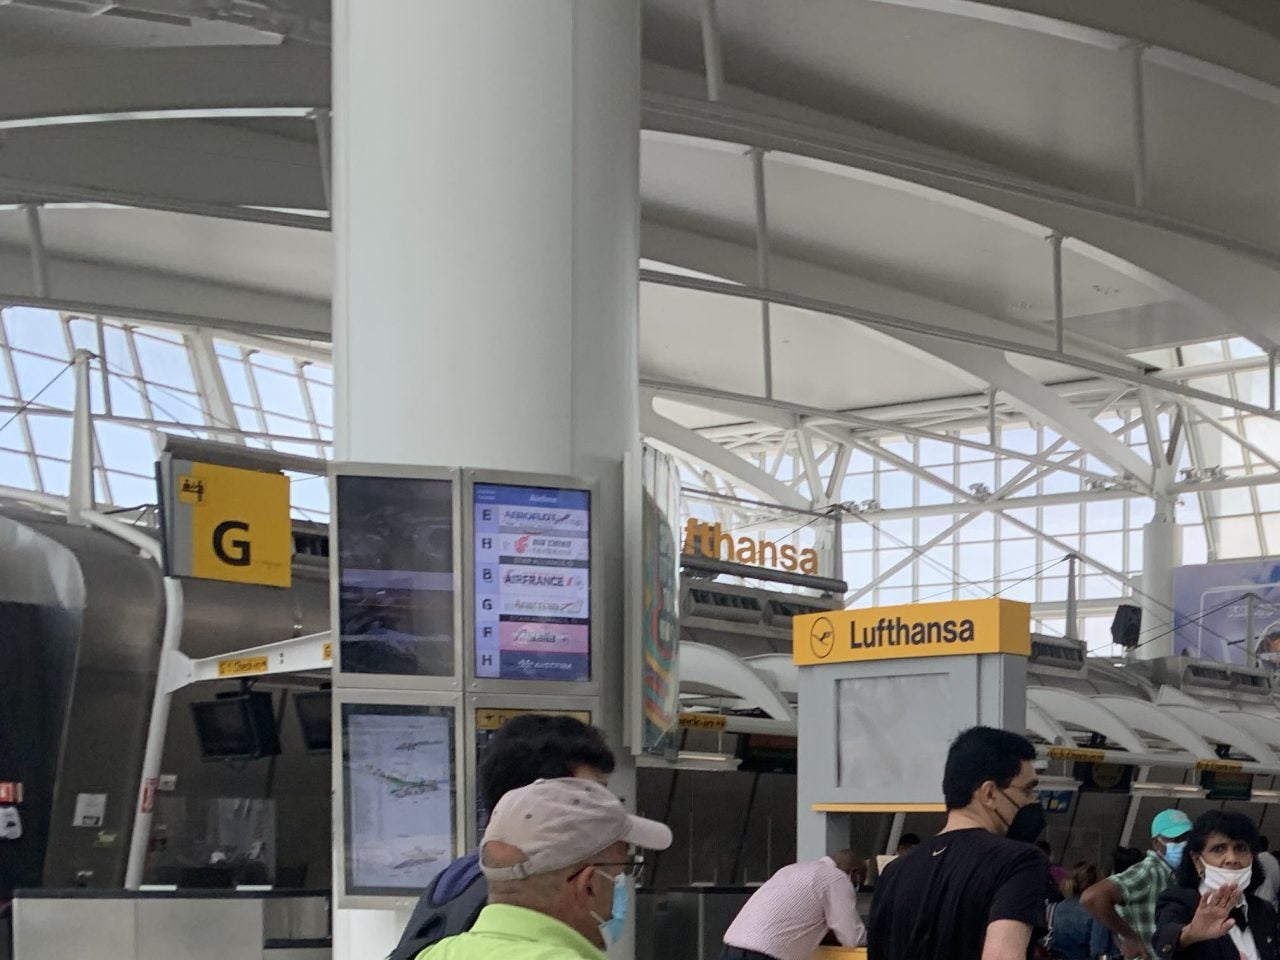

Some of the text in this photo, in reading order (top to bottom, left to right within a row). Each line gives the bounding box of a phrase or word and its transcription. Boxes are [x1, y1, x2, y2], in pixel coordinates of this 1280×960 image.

[482, 509, 492, 521] E
[211, 519, 251, 566] G
[482, 538, 492, 549] H
[684, 517, 818, 575] fthansa
[850, 617, 974, 649] Lufthansa
[482, 654, 492, 666] H
